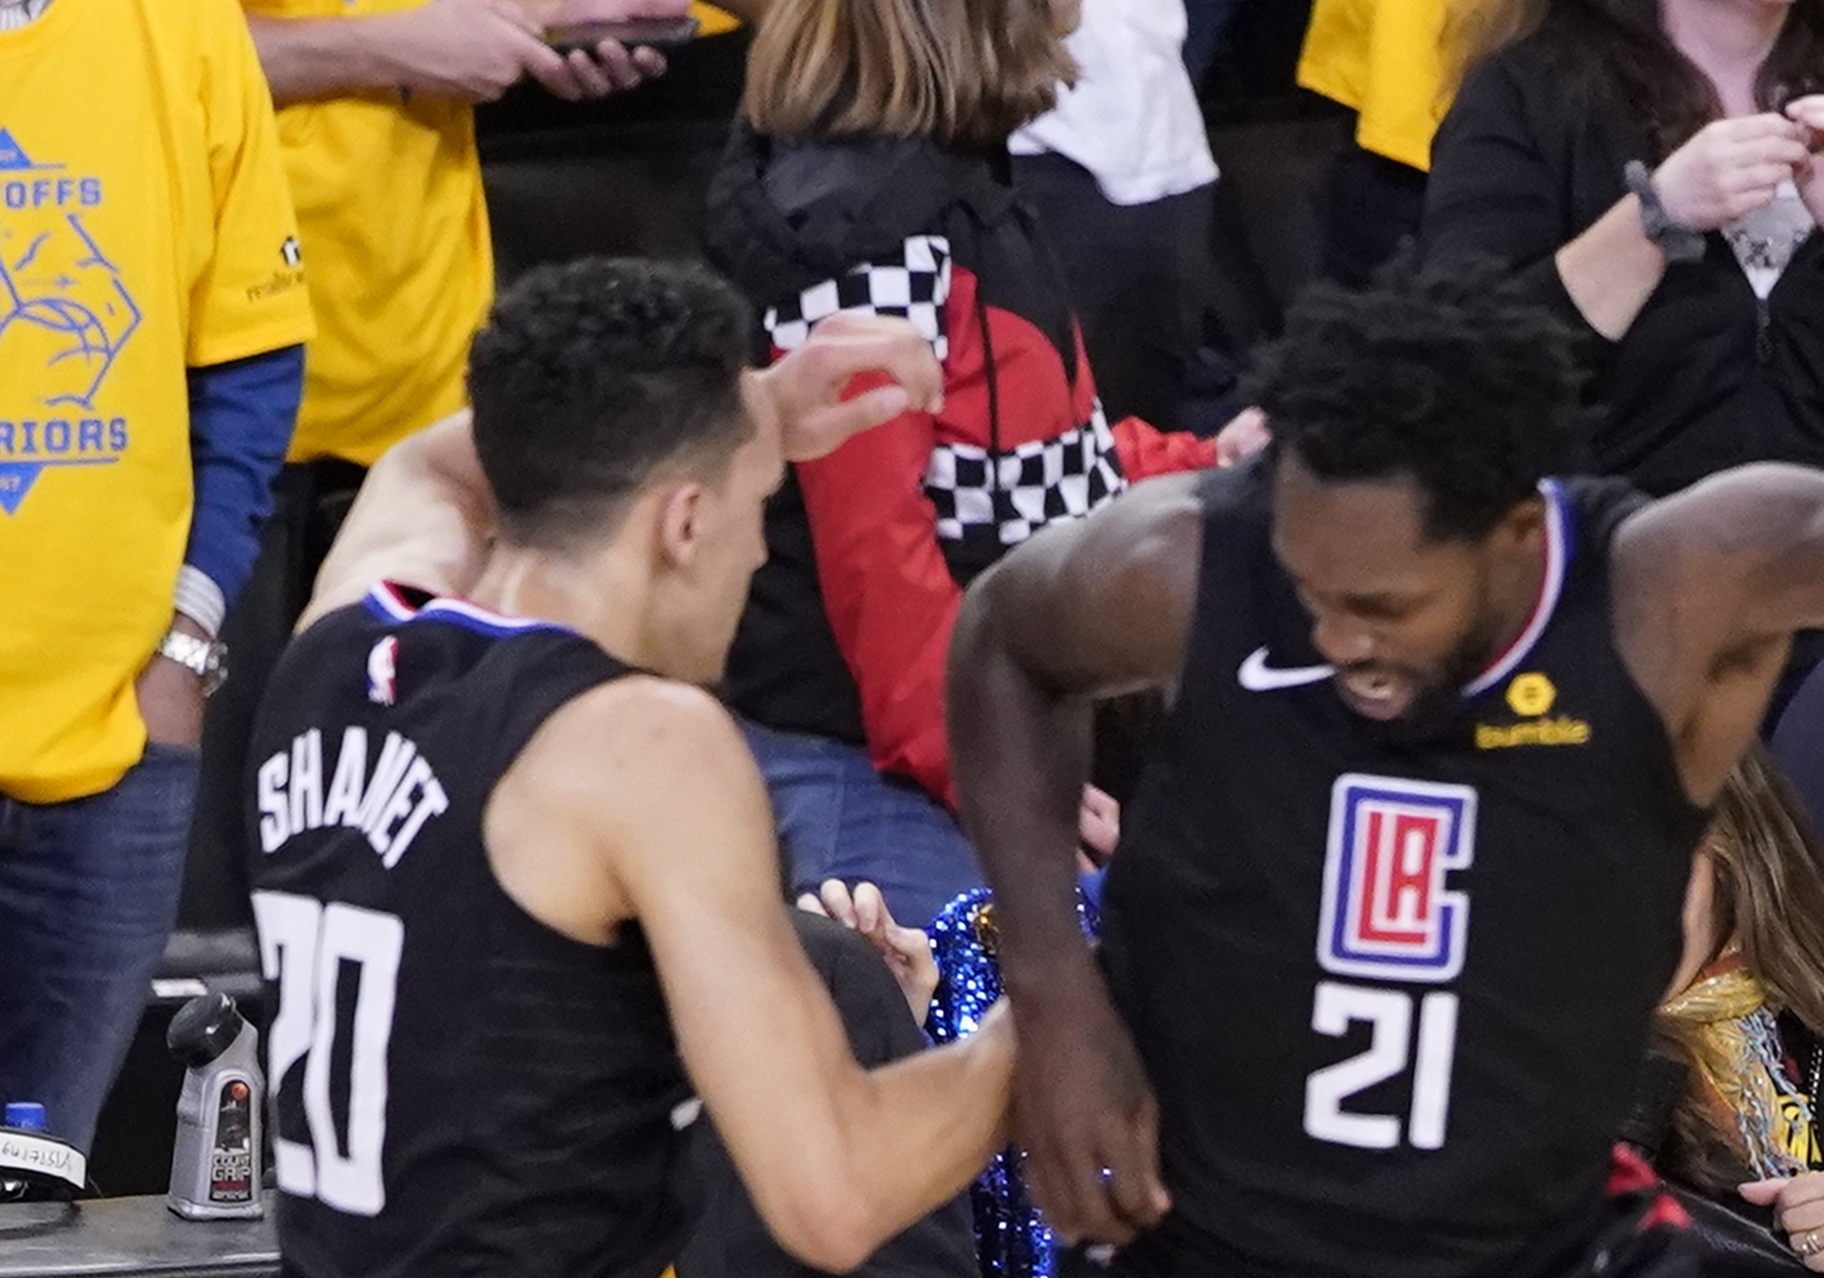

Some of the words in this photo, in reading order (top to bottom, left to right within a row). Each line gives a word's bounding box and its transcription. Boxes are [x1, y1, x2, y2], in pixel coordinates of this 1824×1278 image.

[0, 417, 128, 454] RIORS
[250, 888, 405, 1218] 20
[1303, 980, 1460, 1150] 21
